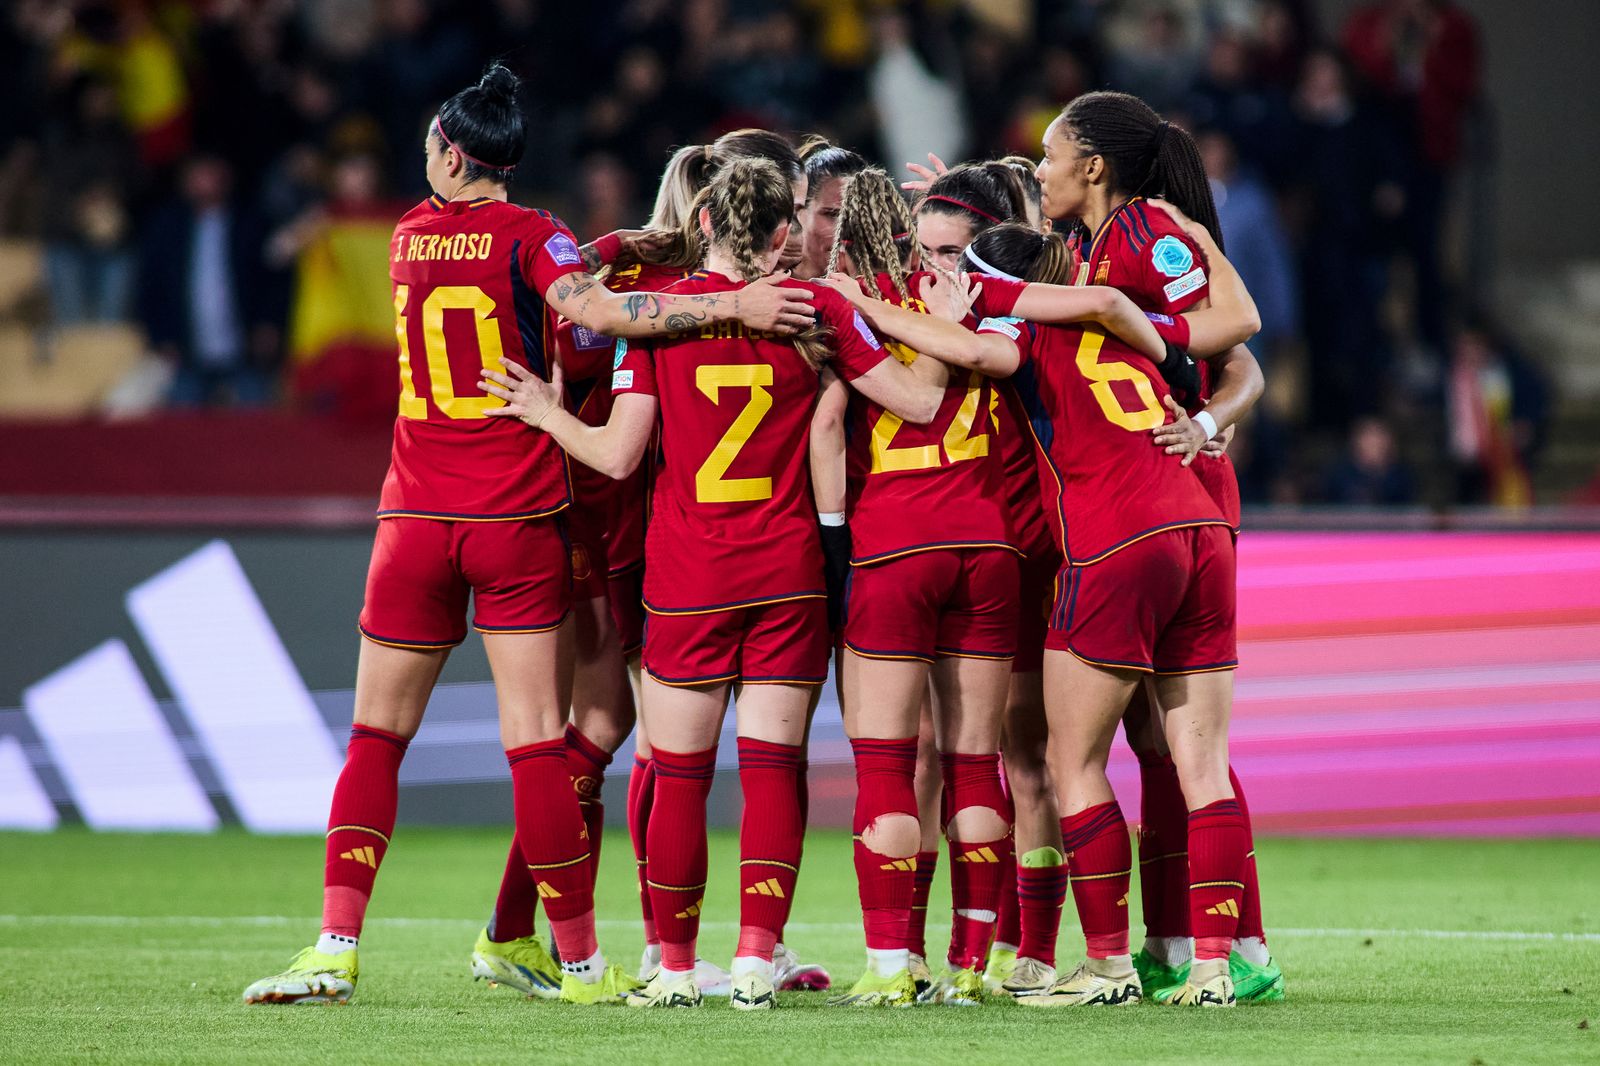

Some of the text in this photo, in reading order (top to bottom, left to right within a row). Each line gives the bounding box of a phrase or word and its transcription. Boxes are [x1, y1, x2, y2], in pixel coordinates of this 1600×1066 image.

[406, 233, 493, 262] HERMOSO
[394, 284, 507, 419] 10
[1075, 323, 1166, 432] 6
[695, 364, 774, 503] 2
